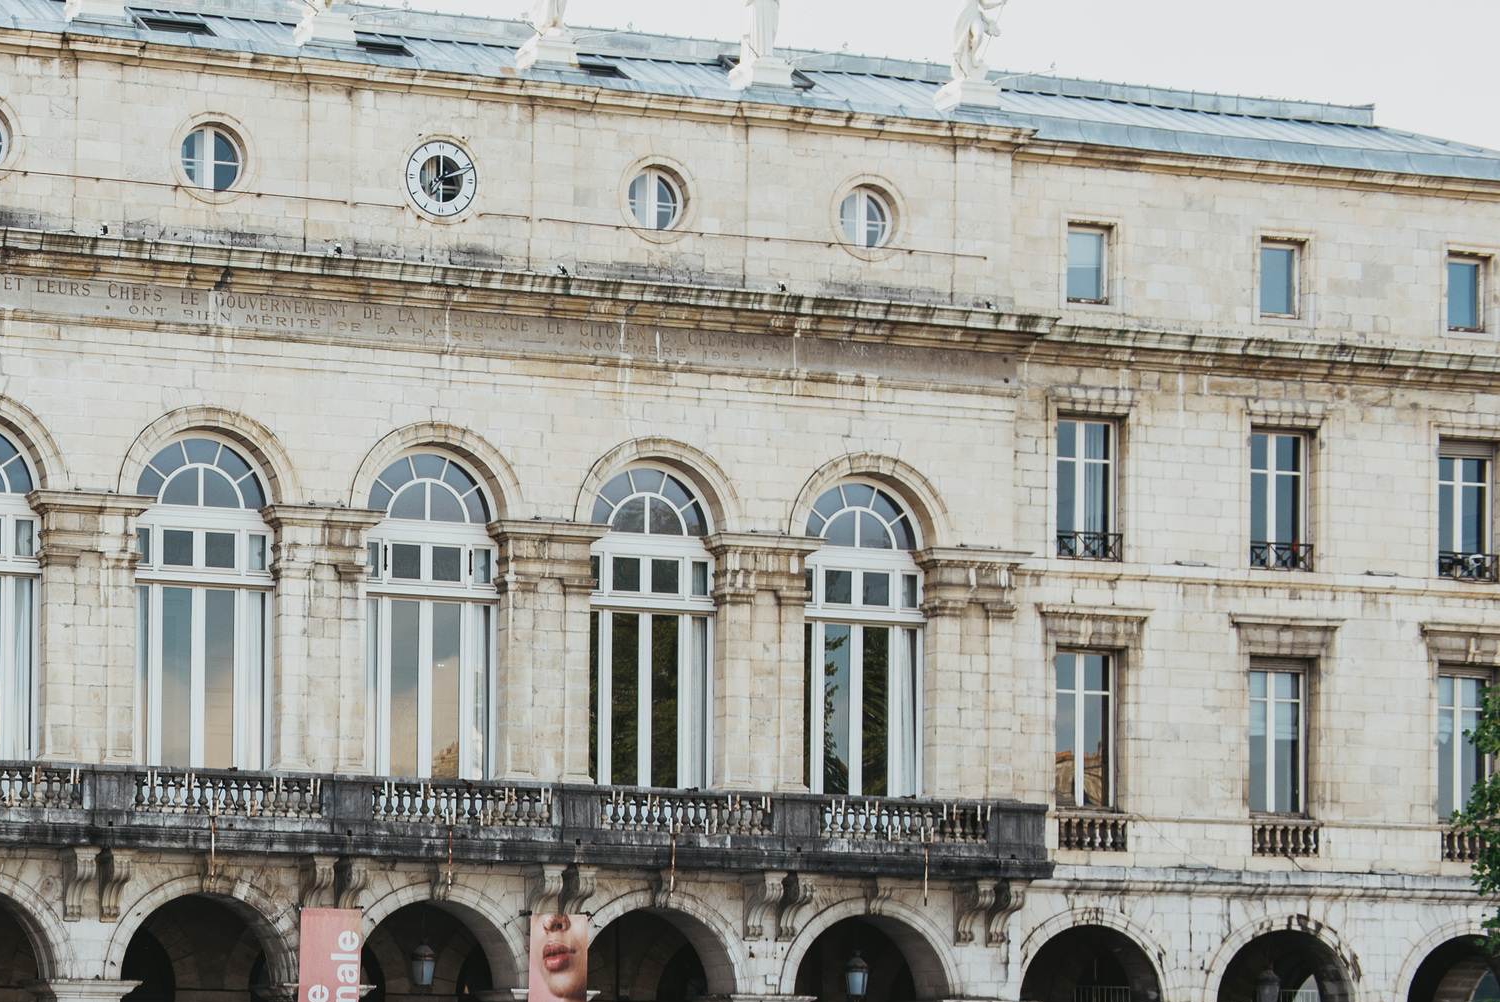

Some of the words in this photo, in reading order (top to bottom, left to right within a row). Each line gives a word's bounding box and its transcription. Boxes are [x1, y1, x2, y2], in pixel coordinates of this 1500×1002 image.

[4, 277, 23, 291] ET
[37, 279, 91, 297] LEURS
[108, 283, 162, 302] CHEFS
[181, 292, 199, 306] LE
[215, 293, 348, 317] GOUVERNEMENT
[363, 306, 382, 320] DE
[398, 309, 416, 324] LA
[547, 322, 564, 335] LE
[579, 324, 646, 342] CITOYEN
[129, 305, 167, 317] ONT
[183, 309, 231, 322] BIEN
[246, 313, 321, 330] MÉRITÉ
[337, 321, 361, 332] DE
[376, 324, 398, 336] LA
[412, 327, 484, 342] PATRIE
[579, 341, 686, 358] NOVEMBRE
